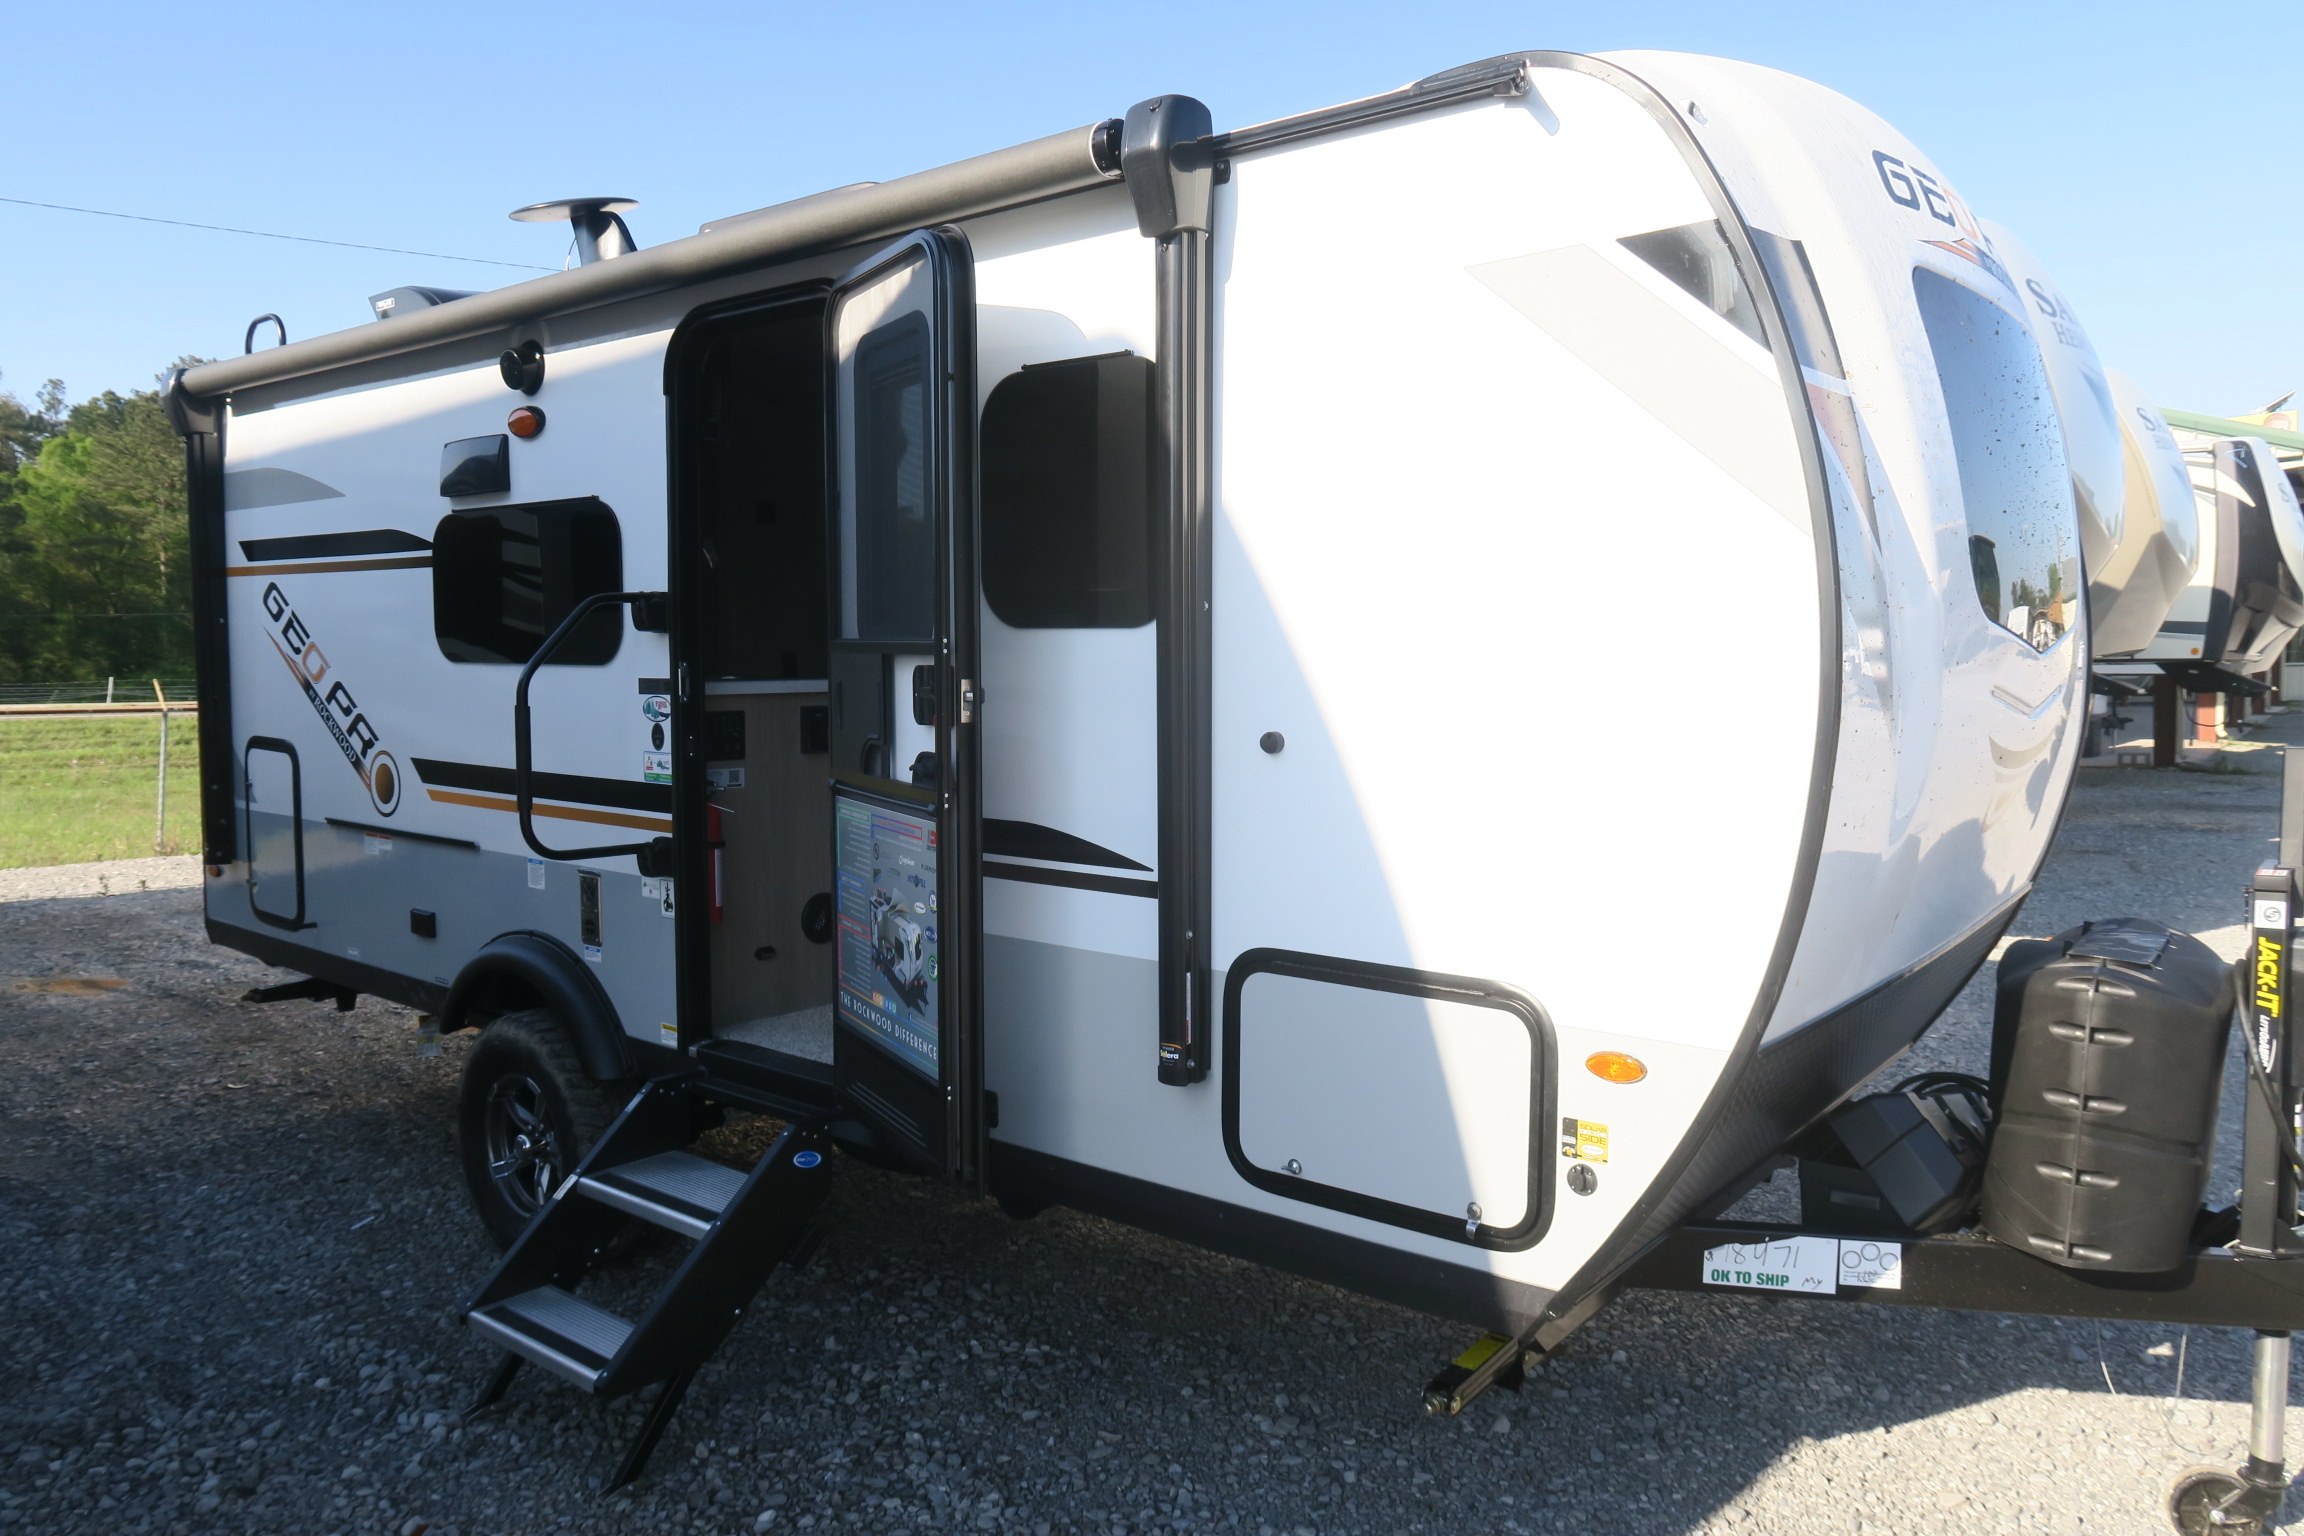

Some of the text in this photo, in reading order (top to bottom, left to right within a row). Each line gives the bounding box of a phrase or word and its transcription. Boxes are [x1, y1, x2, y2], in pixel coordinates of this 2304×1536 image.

[263, 582, 400, 817] GEO PRO
[314, 696, 356, 763] ROCKWOOD
[2256, 936, 2282, 1017] JACK-IT
[840, 991, 851, 1008] THE
[853, 999, 892, 1032] ROCKWOOD
[894, 1024, 937, 1060] DIFFERENCE
[1579, 1123, 1607, 1134] SOLAR
[1579, 1133, 1607, 1146] SIDE
[1711, 1269, 1790, 1286] OK TO SHIP
